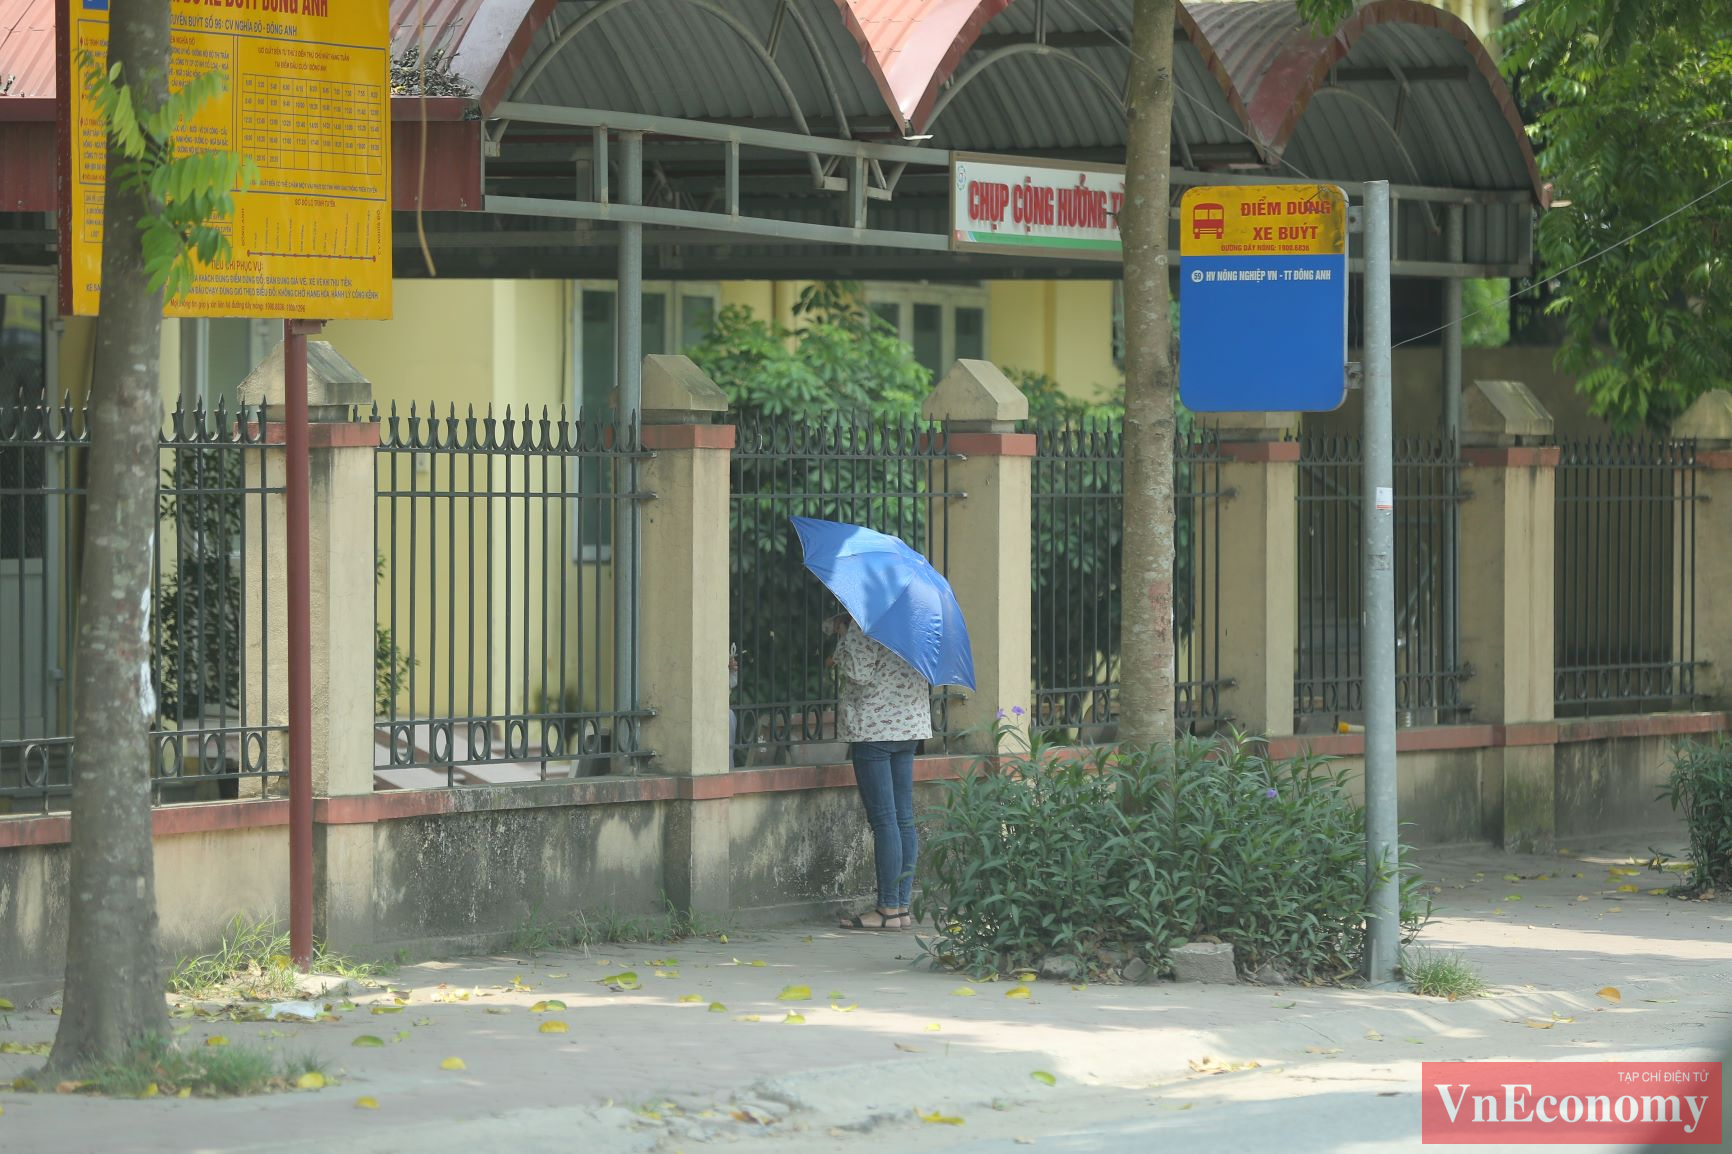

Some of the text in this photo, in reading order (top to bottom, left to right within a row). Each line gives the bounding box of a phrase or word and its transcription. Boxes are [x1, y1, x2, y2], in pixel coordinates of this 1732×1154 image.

[284, 24, 298, 36] ANH
[968, 180, 1009, 230] CHỤP
[1013, 176, 1054, 232] CỘNG
[1056, 173, 1107, 229] HƯỞNG
[1240, 196, 1332, 216] ĐIỂM DỪNG
[1252, 222, 1318, 240] XE BUÝT
[1206, 271, 1217, 281] HV
[1217, 269, 1238, 281] NÔNG
[1239, 268, 1266, 283] NGHIỆP
[1268, 271, 1278, 281] VN
[1284, 270, 1292, 280] TT
[1294, 268, 1313, 280] ĐÔNG
[1314, 270, 1331, 280] ANH
